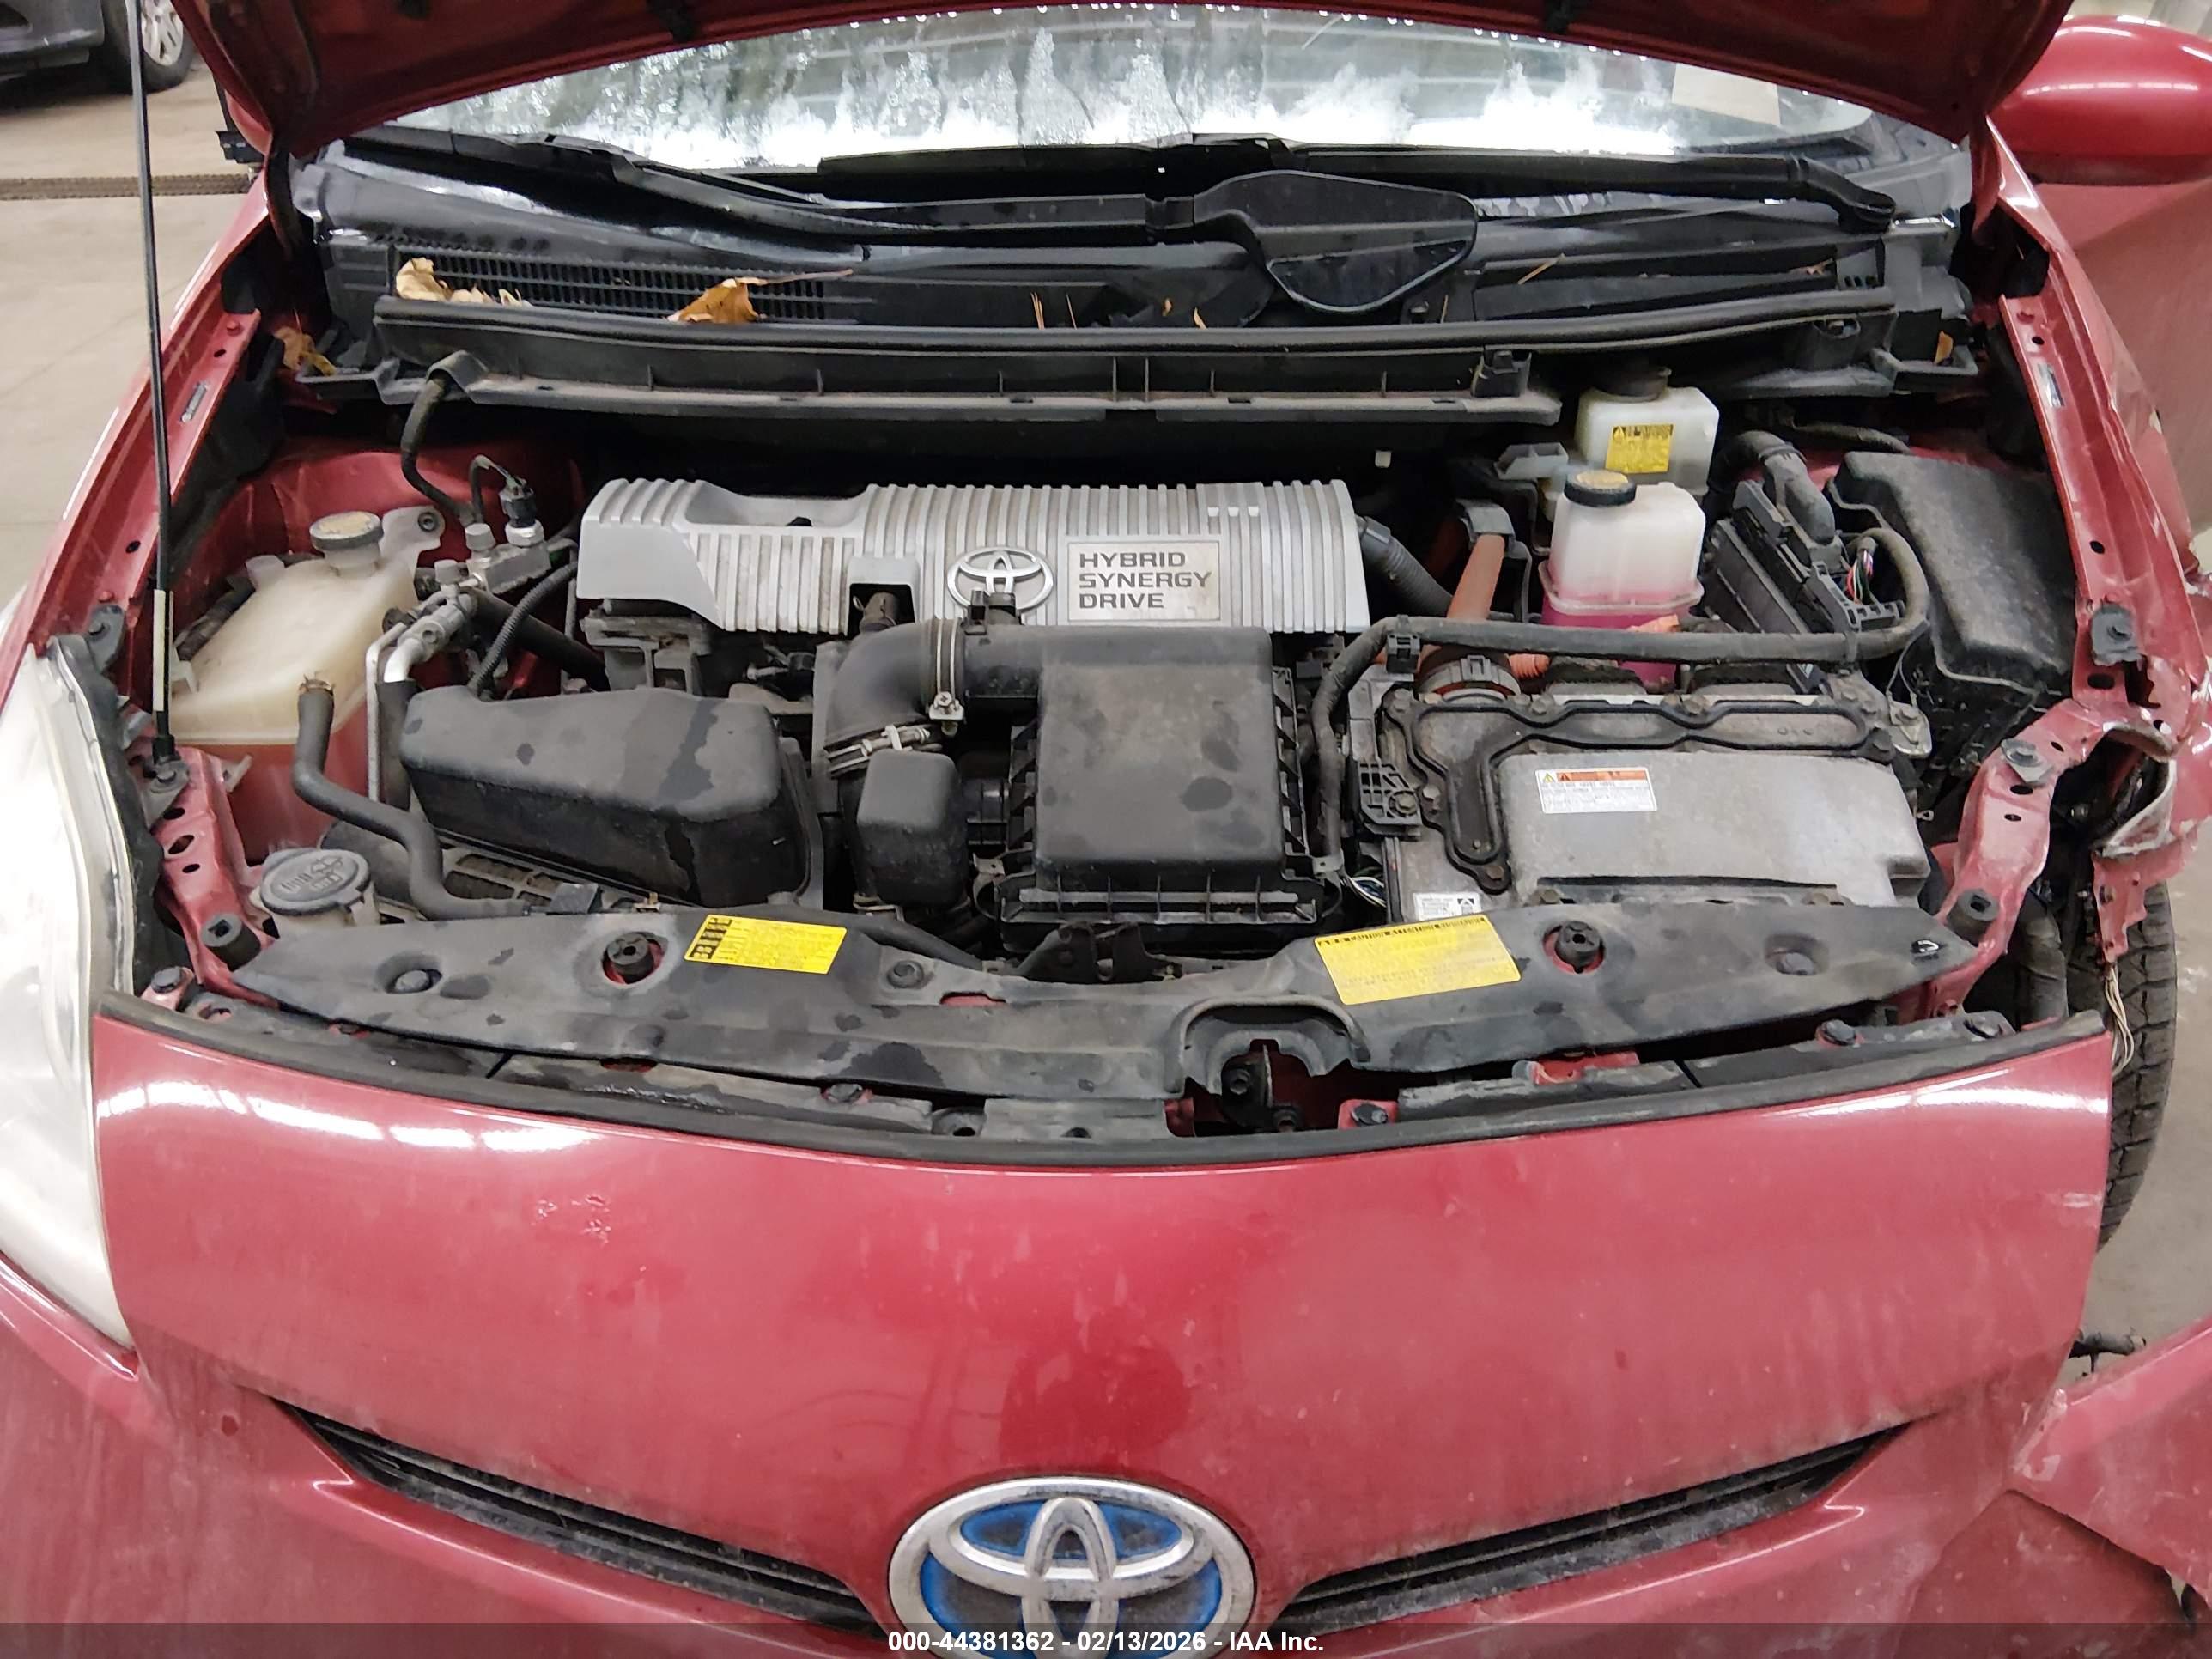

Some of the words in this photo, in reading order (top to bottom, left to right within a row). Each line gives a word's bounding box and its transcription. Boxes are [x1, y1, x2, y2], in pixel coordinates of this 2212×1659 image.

[1079, 552, 1186, 568] HYBRID
[1079, 572, 1212, 588] SYNERGY
[1079, 593, 1164, 609] DRIVE
